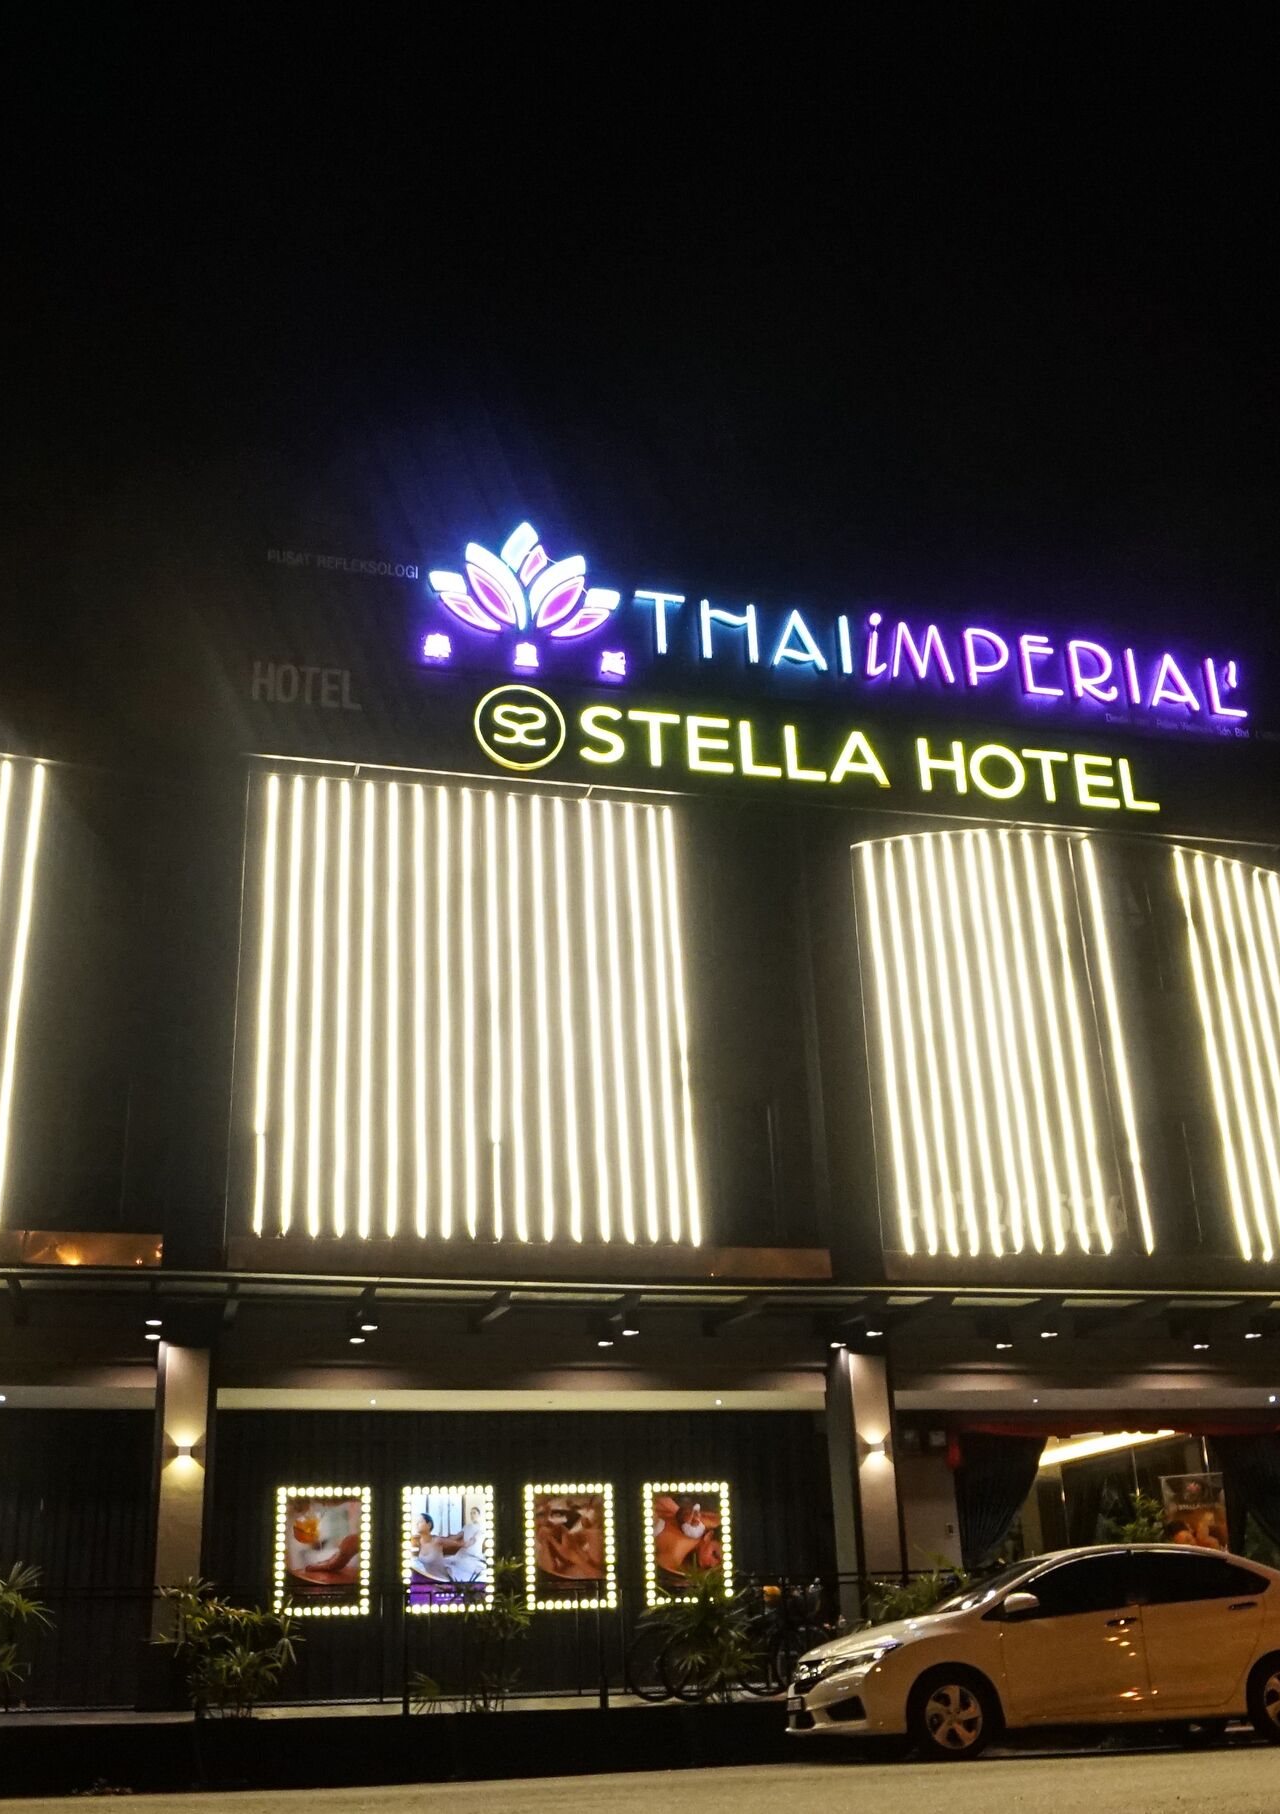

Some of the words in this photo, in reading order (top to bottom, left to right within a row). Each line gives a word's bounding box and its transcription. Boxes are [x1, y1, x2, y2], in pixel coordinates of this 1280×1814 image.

[267, 549, 310, 566] PUSAT
[317, 555, 419, 580] REFLEKSOLOGI
[252, 661, 363, 711] HOTEL
[578, 704, 892, 789] STELLA
[916, 736, 1162, 813] HOTEL
